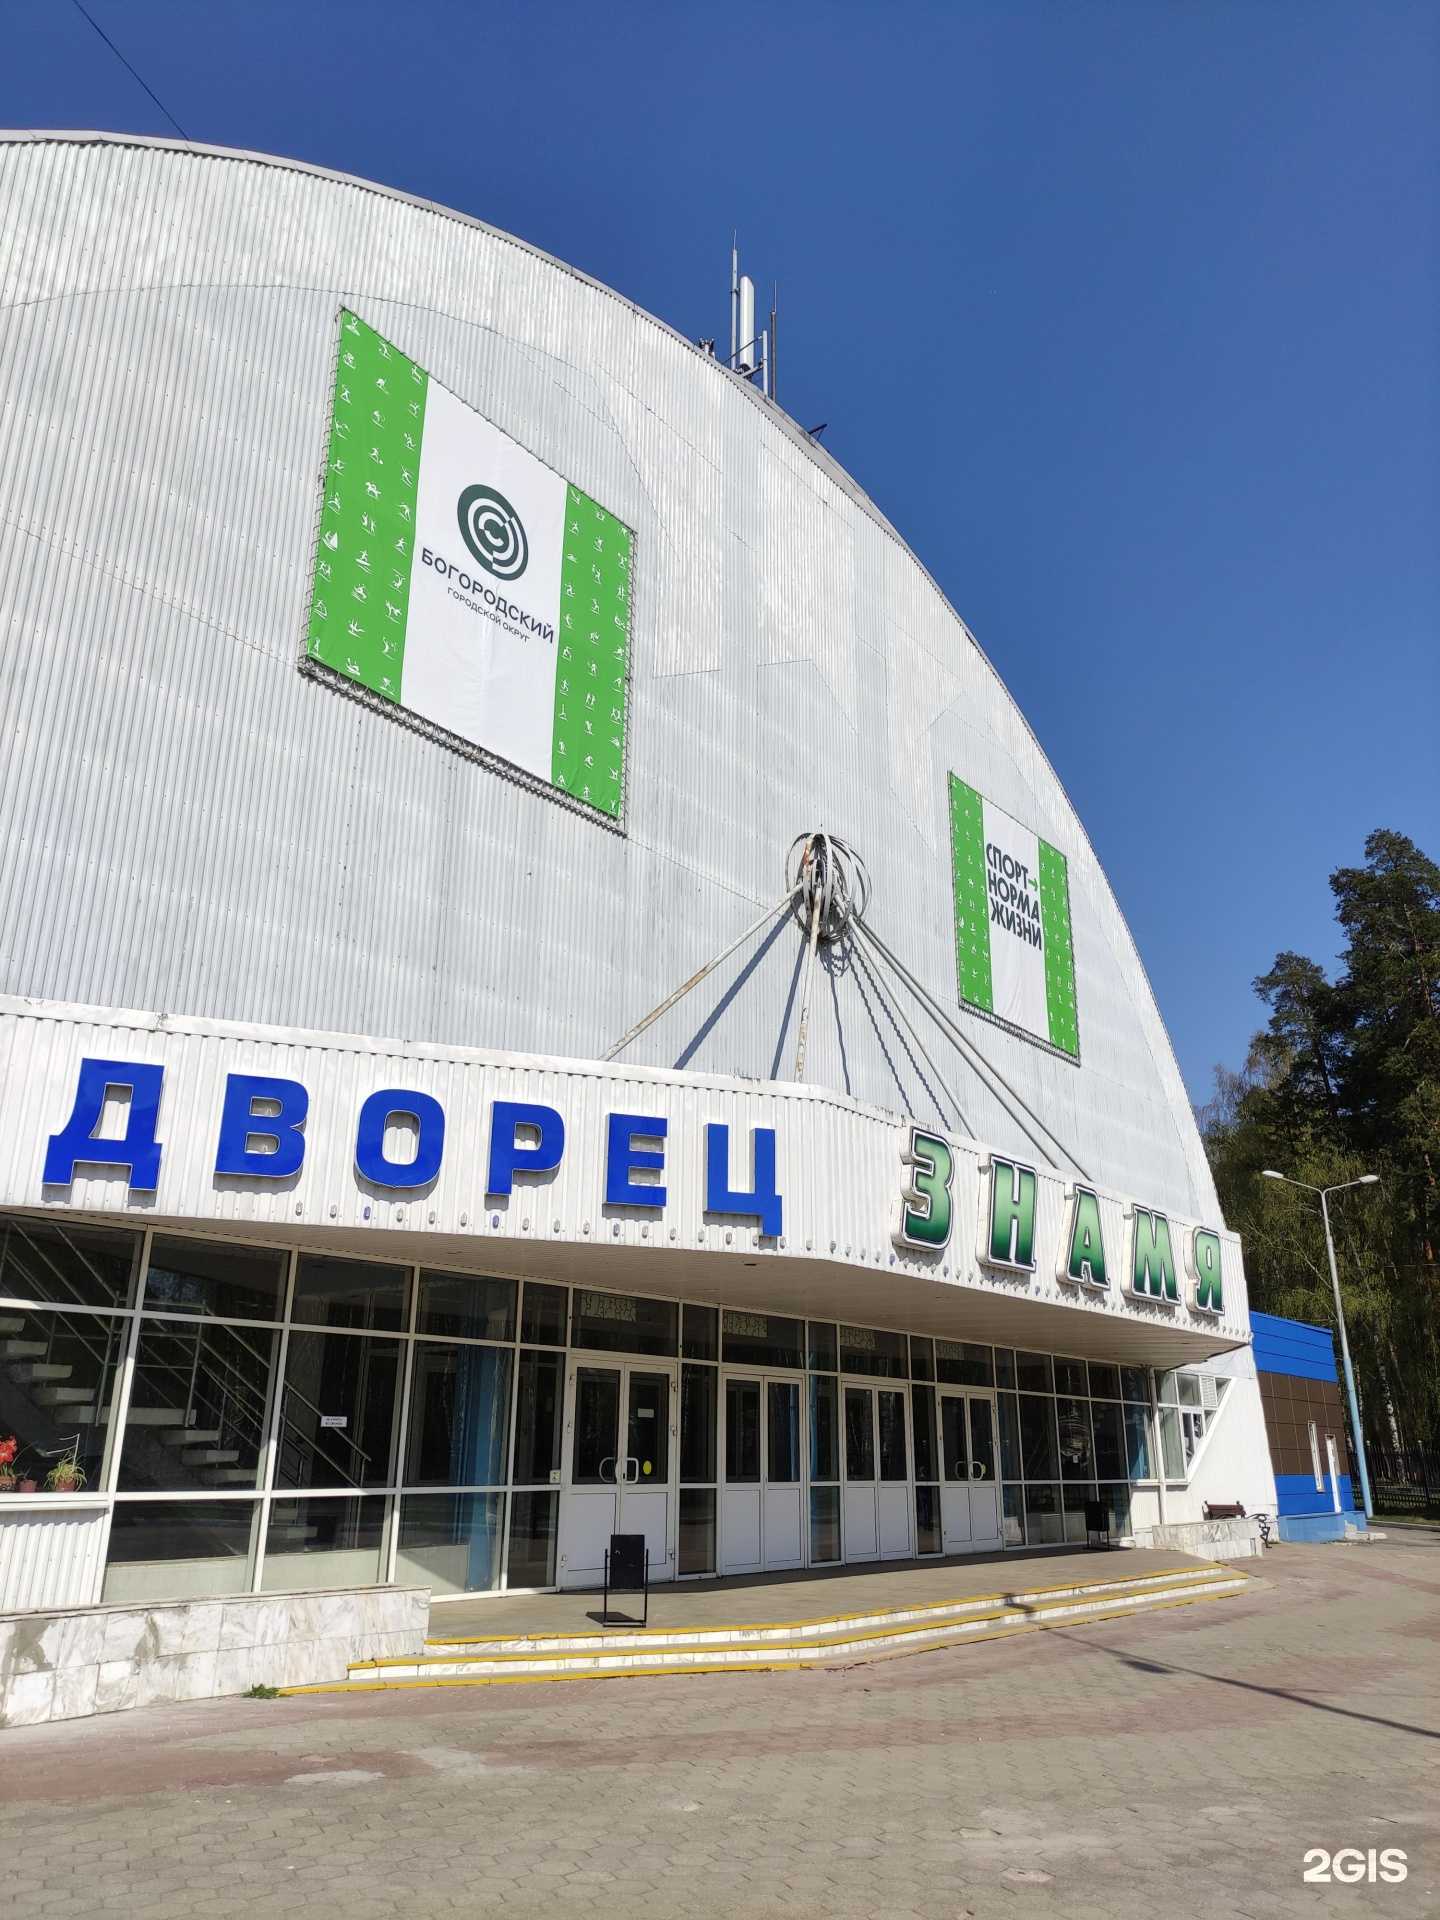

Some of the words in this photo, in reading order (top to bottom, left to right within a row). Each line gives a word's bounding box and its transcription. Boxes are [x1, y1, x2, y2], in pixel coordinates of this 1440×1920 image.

[421, 547, 555, 644] БОГОРОДСКИЙ
[447, 586, 501, 626] ГОРОДСКОЙ
[502, 621, 531, 643] ОКРУГ
[985, 843, 1029, 890] СПОРТ
[987, 868, 1041, 924] НОРМА
[989, 896, 1042, 951] ЖИЗНИ
[42, 1057, 783, 1237] ДВОРЕЦ
[897, 1126, 1226, 1317] ЗНАМЯ
